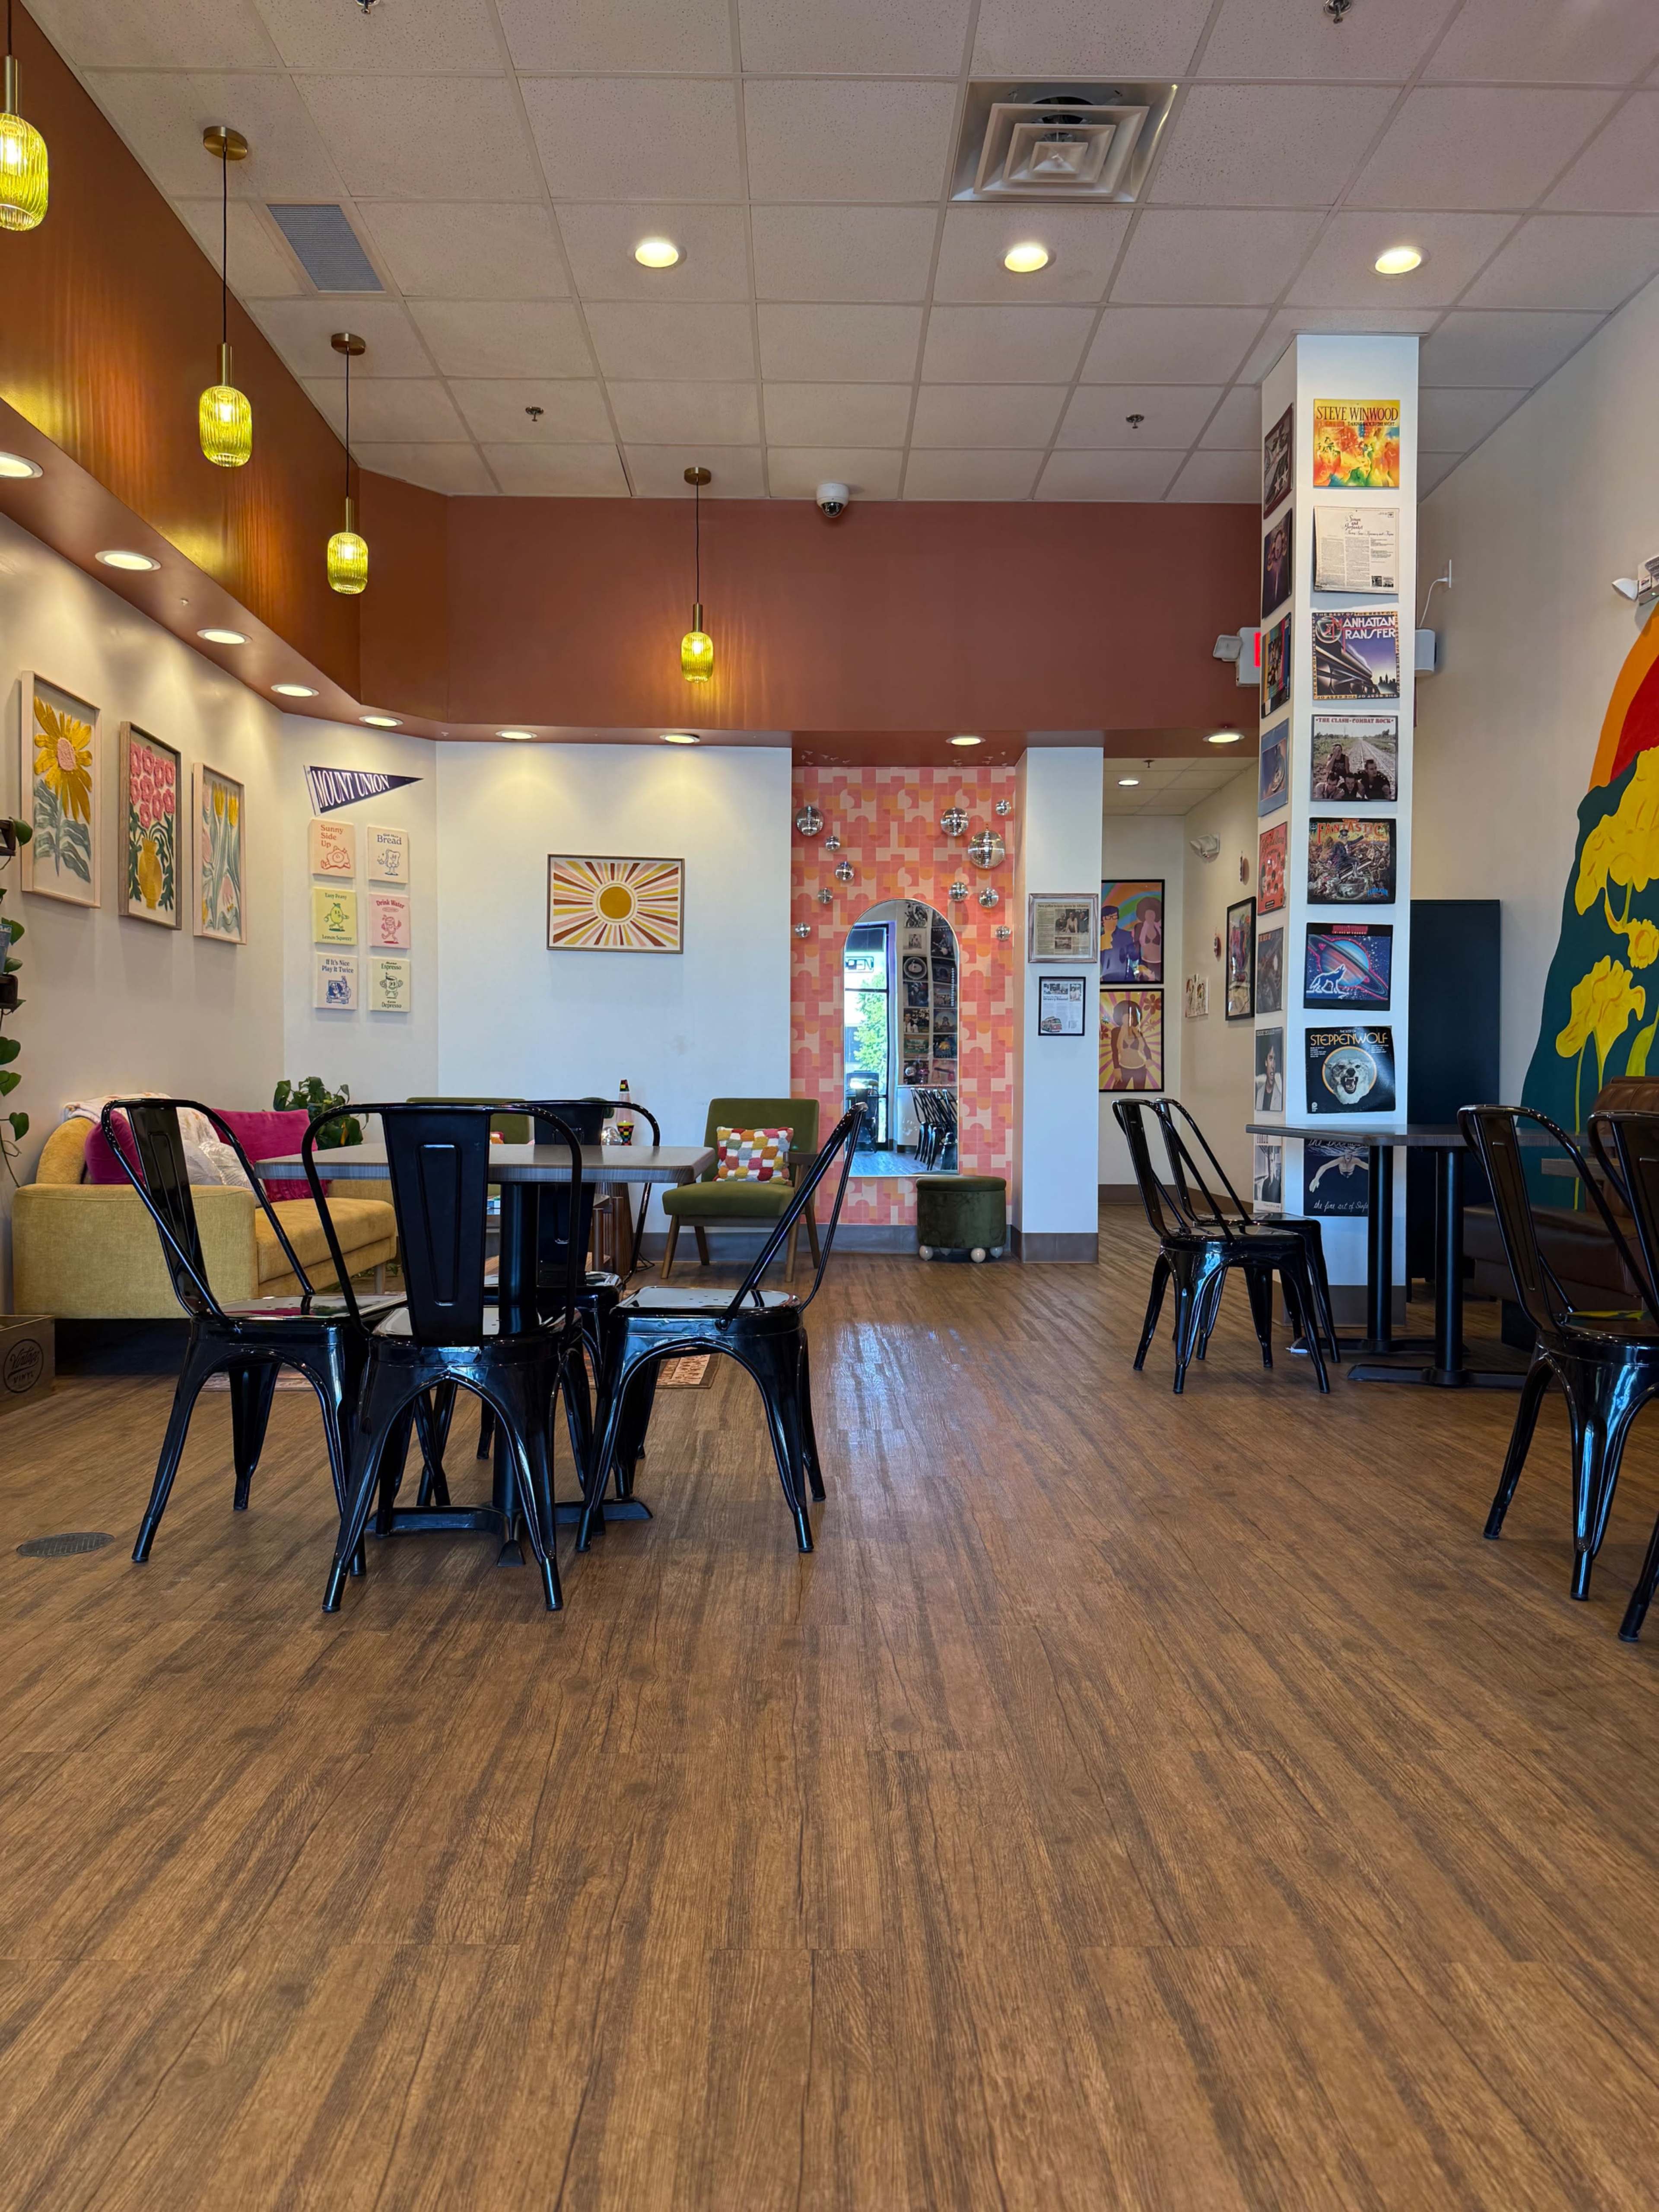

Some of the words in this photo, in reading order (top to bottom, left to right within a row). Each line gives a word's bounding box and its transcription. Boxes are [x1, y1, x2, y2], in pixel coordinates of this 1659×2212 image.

[1316, 406, 1347, 420] STEVE
[1349, 407, 1398, 421] WINWOOD
[312, 770, 355, 808] MOUNT
[354, 773, 391, 797] UNION
[321, 824, 344, 834] Sunny
[1317, 822, 1383, 844] FANTASTIC
[321, 832, 337, 840] Side
[377, 834, 402, 845] Bread
[391, 899, 405, 909] Water
[845, 959, 874, 970] PEN
[1310, 1032, 1389, 1046] STEPPENWOLF
[1313, 1199, 1323, 1209] the
[1323, 1200, 1335, 1213] fine
[1348, 1201, 1355, 1212] of
[10, 1346, 40, 1370] Vintage
[14, 1371, 33, 1383] VINYL
